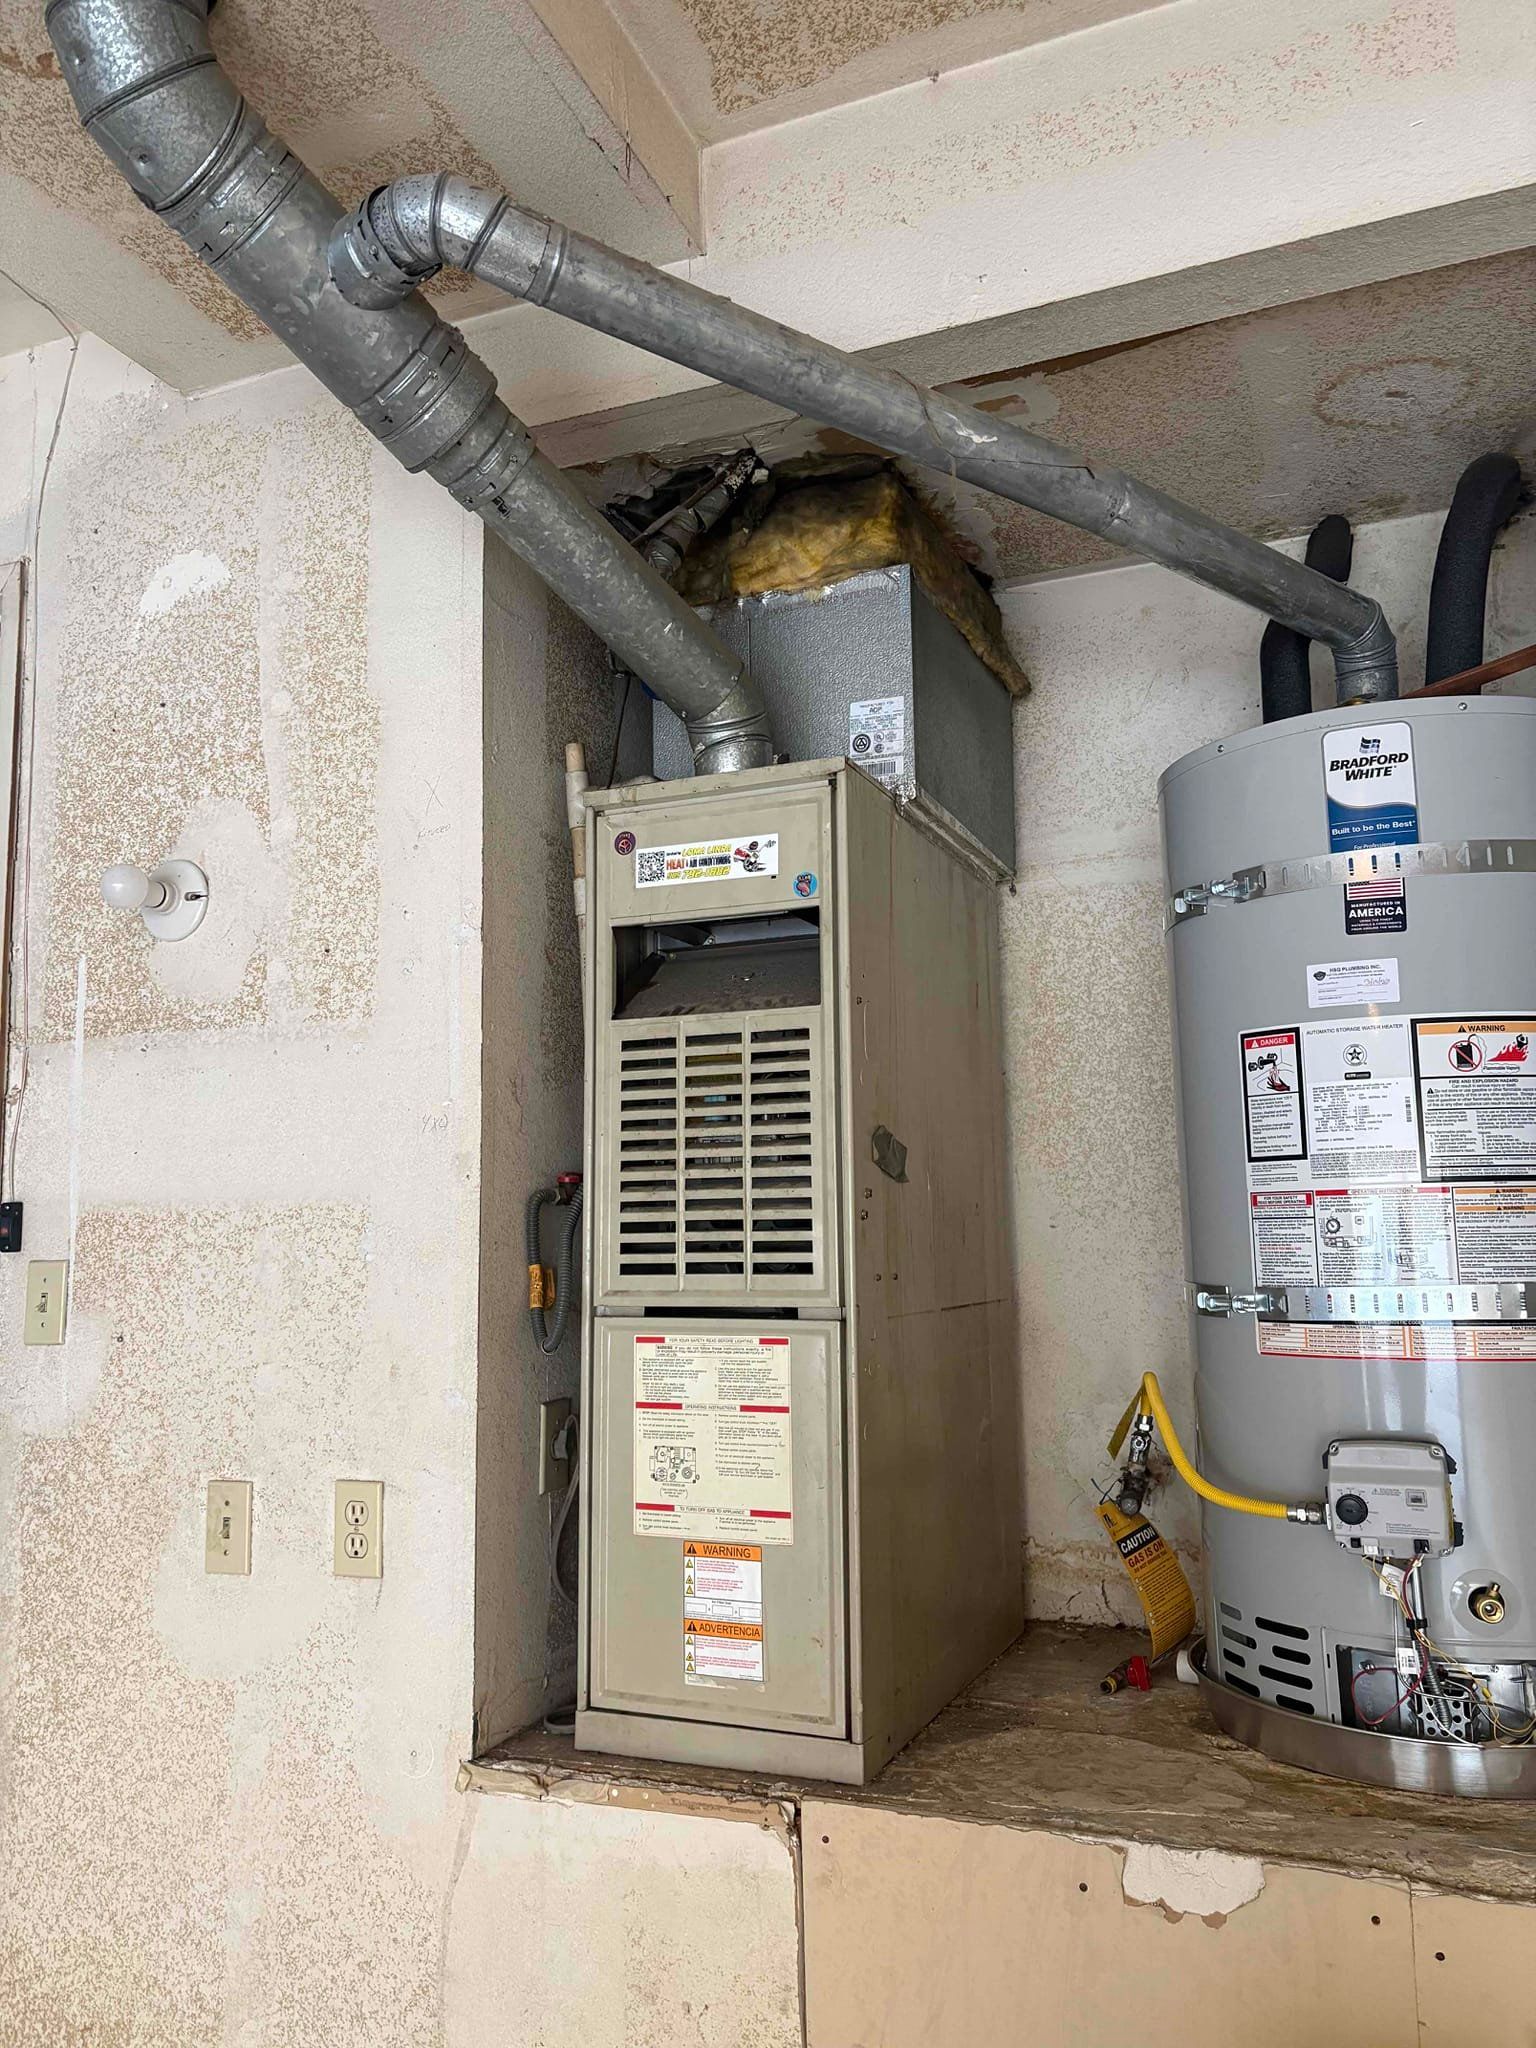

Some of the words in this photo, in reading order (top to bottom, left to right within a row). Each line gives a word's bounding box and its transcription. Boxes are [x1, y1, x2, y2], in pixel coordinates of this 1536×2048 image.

[1329, 753, 1409, 772] BRADFORD
[1345, 766, 1393, 781] WHITE
[1331, 827, 1350, 836] Built
[1363, 824, 1374, 832] be
[1348, 907, 1404, 918] AMERICA
[1467, 1024, 1506, 1032] WARNING
[1260, 1037, 1289, 1047] DANGER
[1120, 1526, 1156, 1554] CAUTION
[703, 1545, 751, 1559] WARNING
[1127, 1552, 1145, 1568] GAS
[1145, 1547, 1153, 1559] IS
[698, 1623, 761, 1637] ADVERTENCIA
